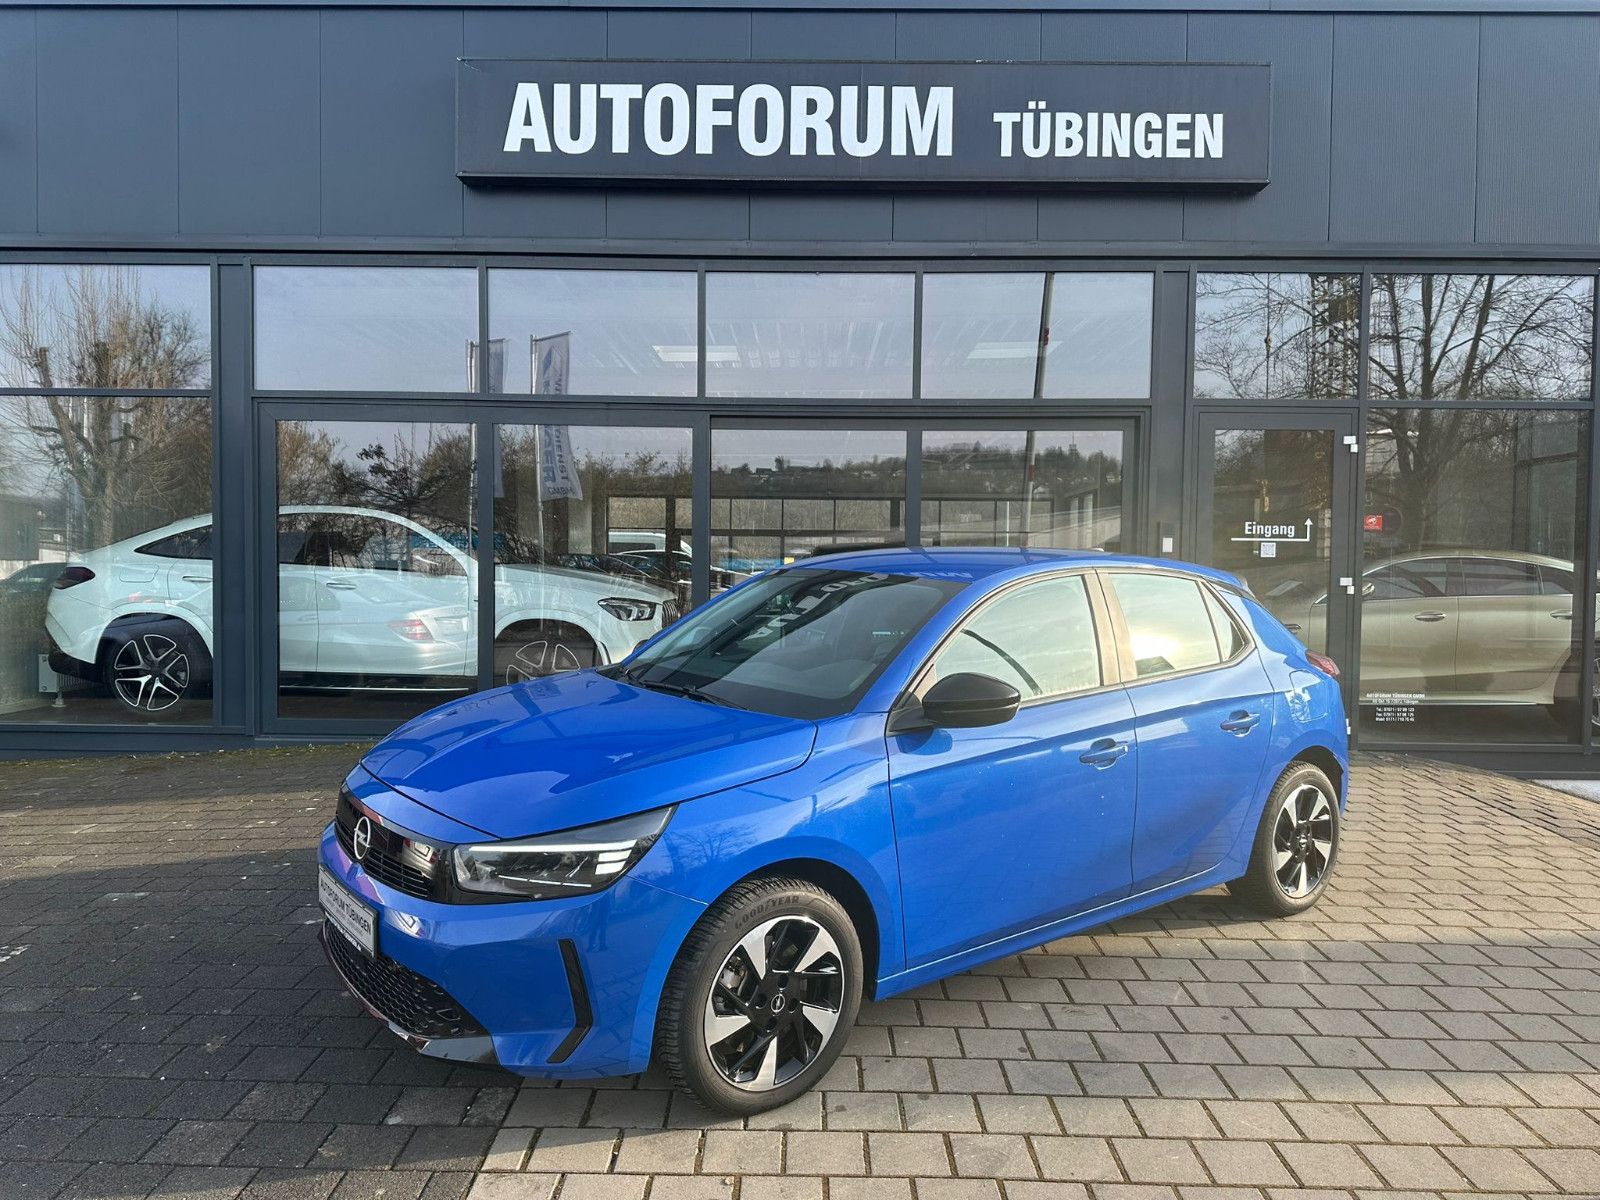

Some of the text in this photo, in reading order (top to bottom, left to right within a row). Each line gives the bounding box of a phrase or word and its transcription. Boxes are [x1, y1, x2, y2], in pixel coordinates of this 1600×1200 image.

[502, 82, 1224, 159] AUTOFORUM TÜBINGEN
[1244, 521, 1295, 538] Eingang
